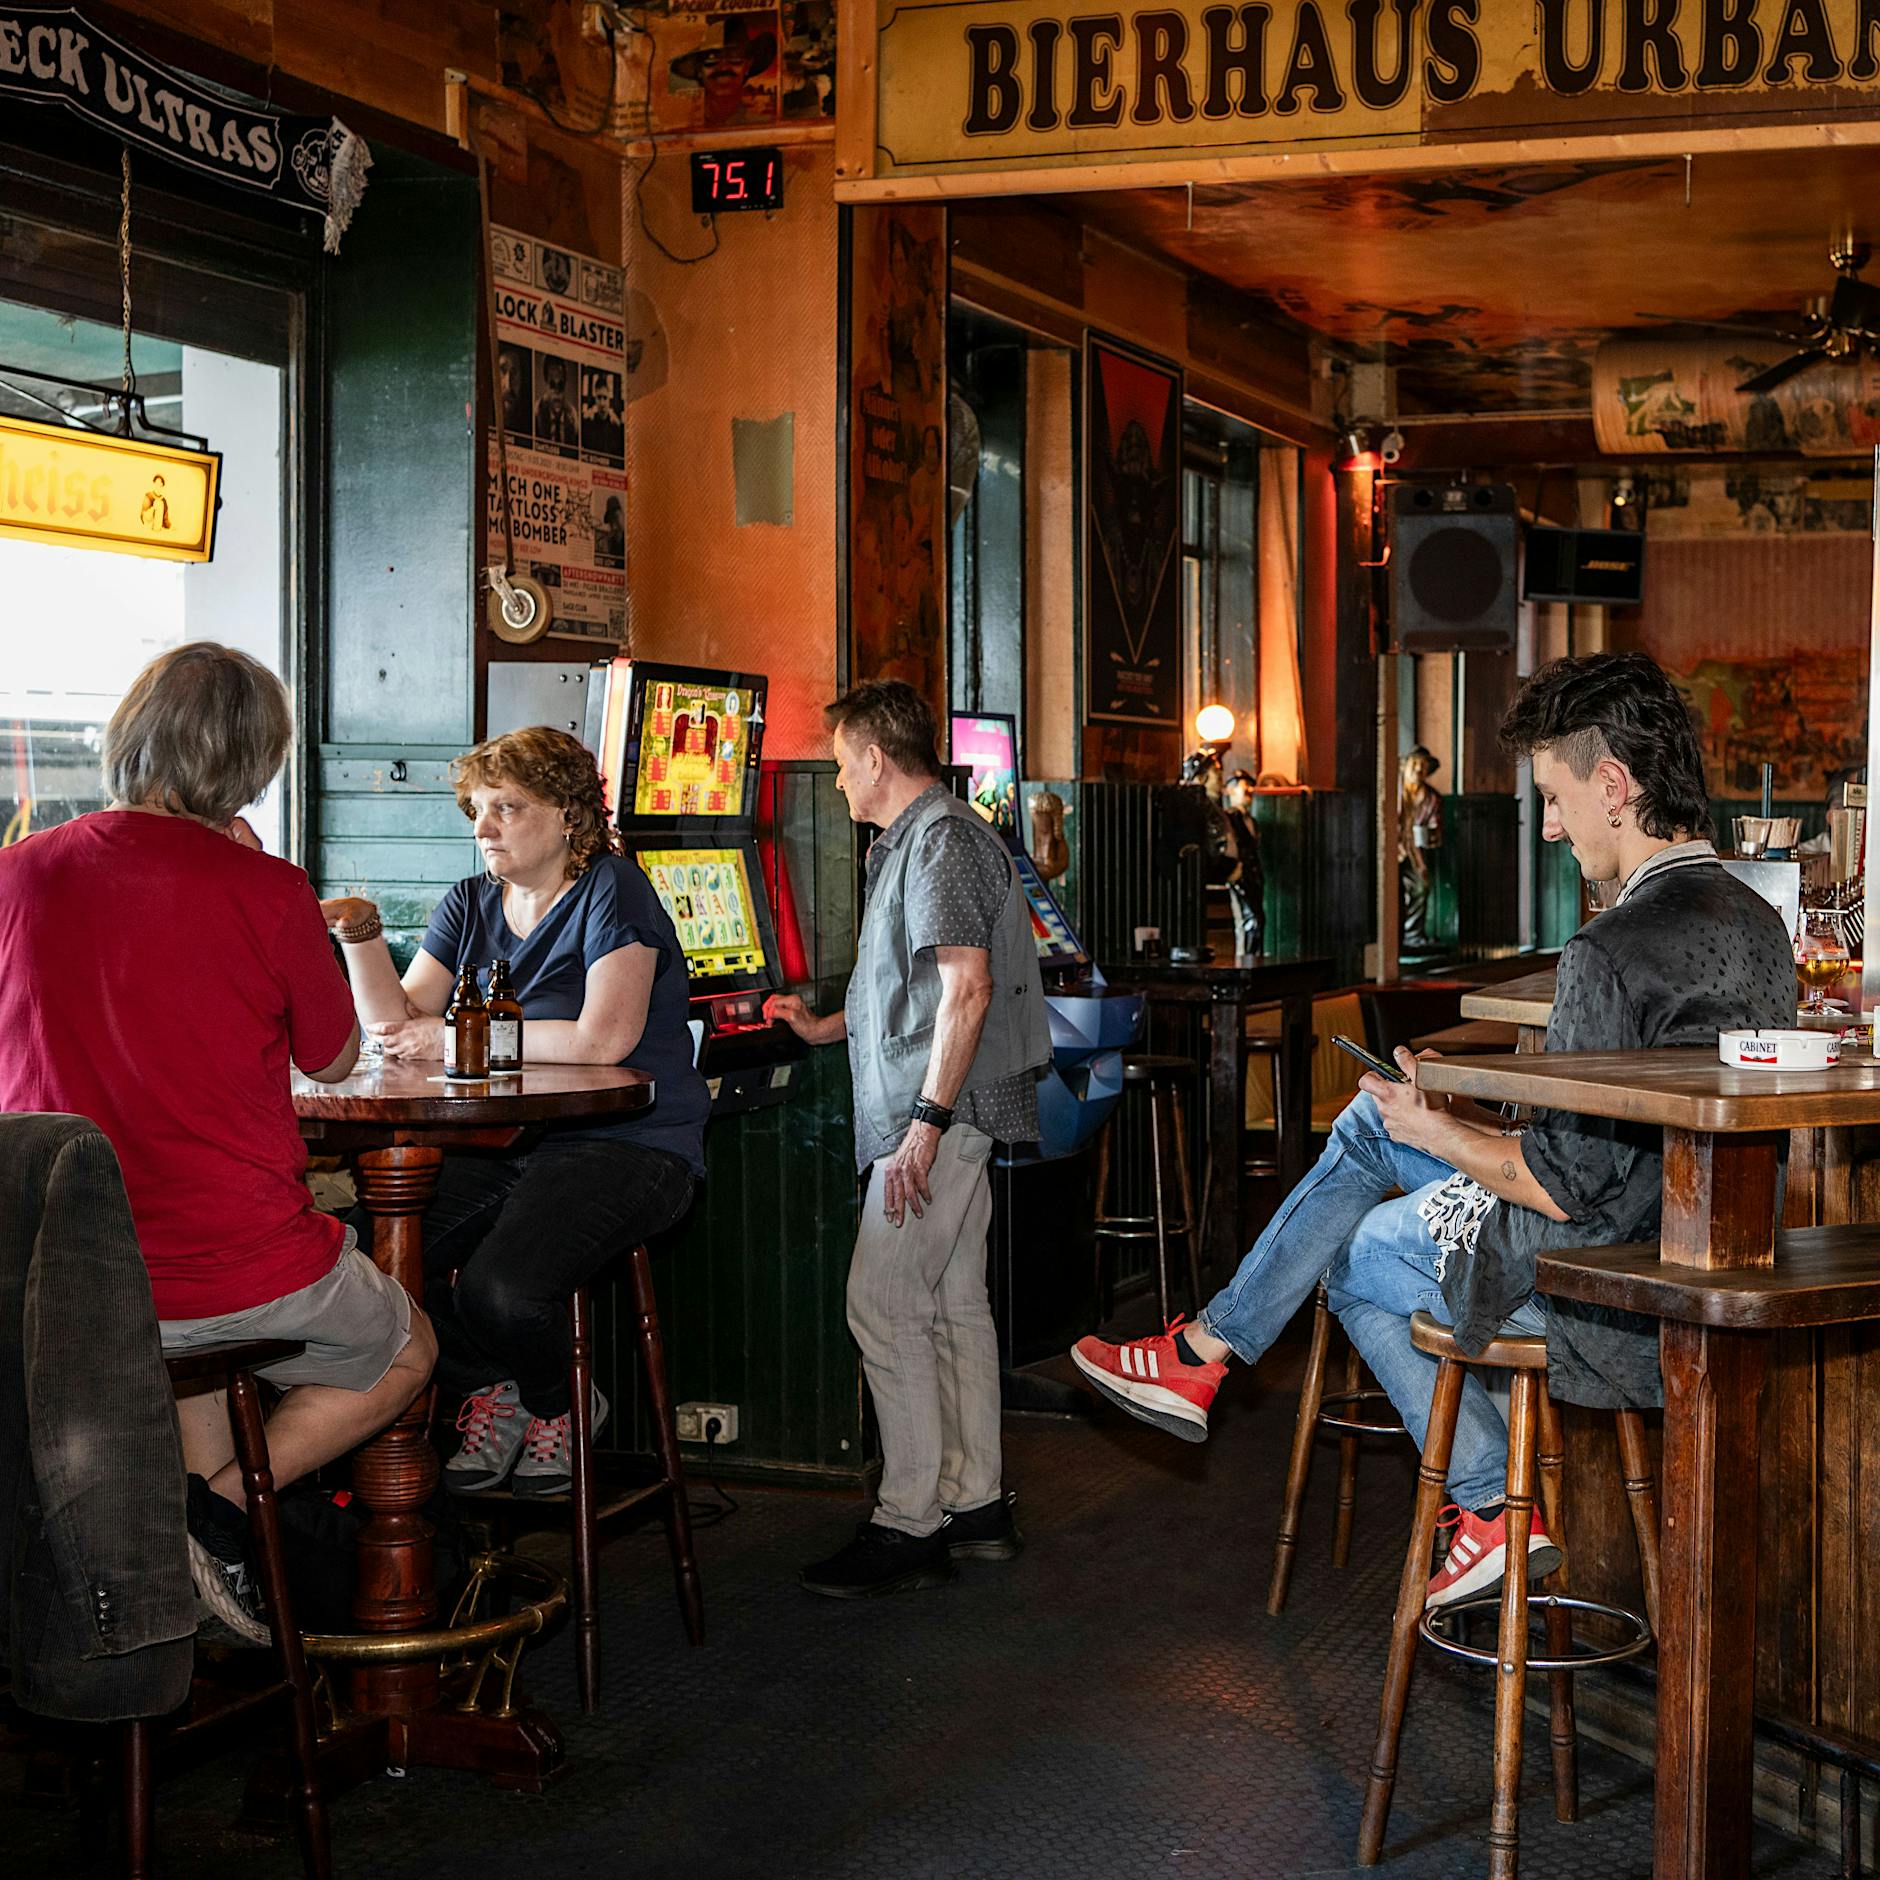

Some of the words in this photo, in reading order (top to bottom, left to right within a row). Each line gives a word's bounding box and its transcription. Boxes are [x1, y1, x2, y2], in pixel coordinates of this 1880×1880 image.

[962, 0, 1482, 136] BIERHAUS
[101, 52, 278, 173] ULTRAS
[702, 161, 774, 200] 75.1
[495, 292, 538, 326] LOCK
[560, 313, 624, 351] BLASTER
[487, 473, 527, 496] MCH
[532, 480, 561, 504] ONE
[513, 518, 567, 547] BOMBER
[1739, 1040, 1777, 1054] CABINET
